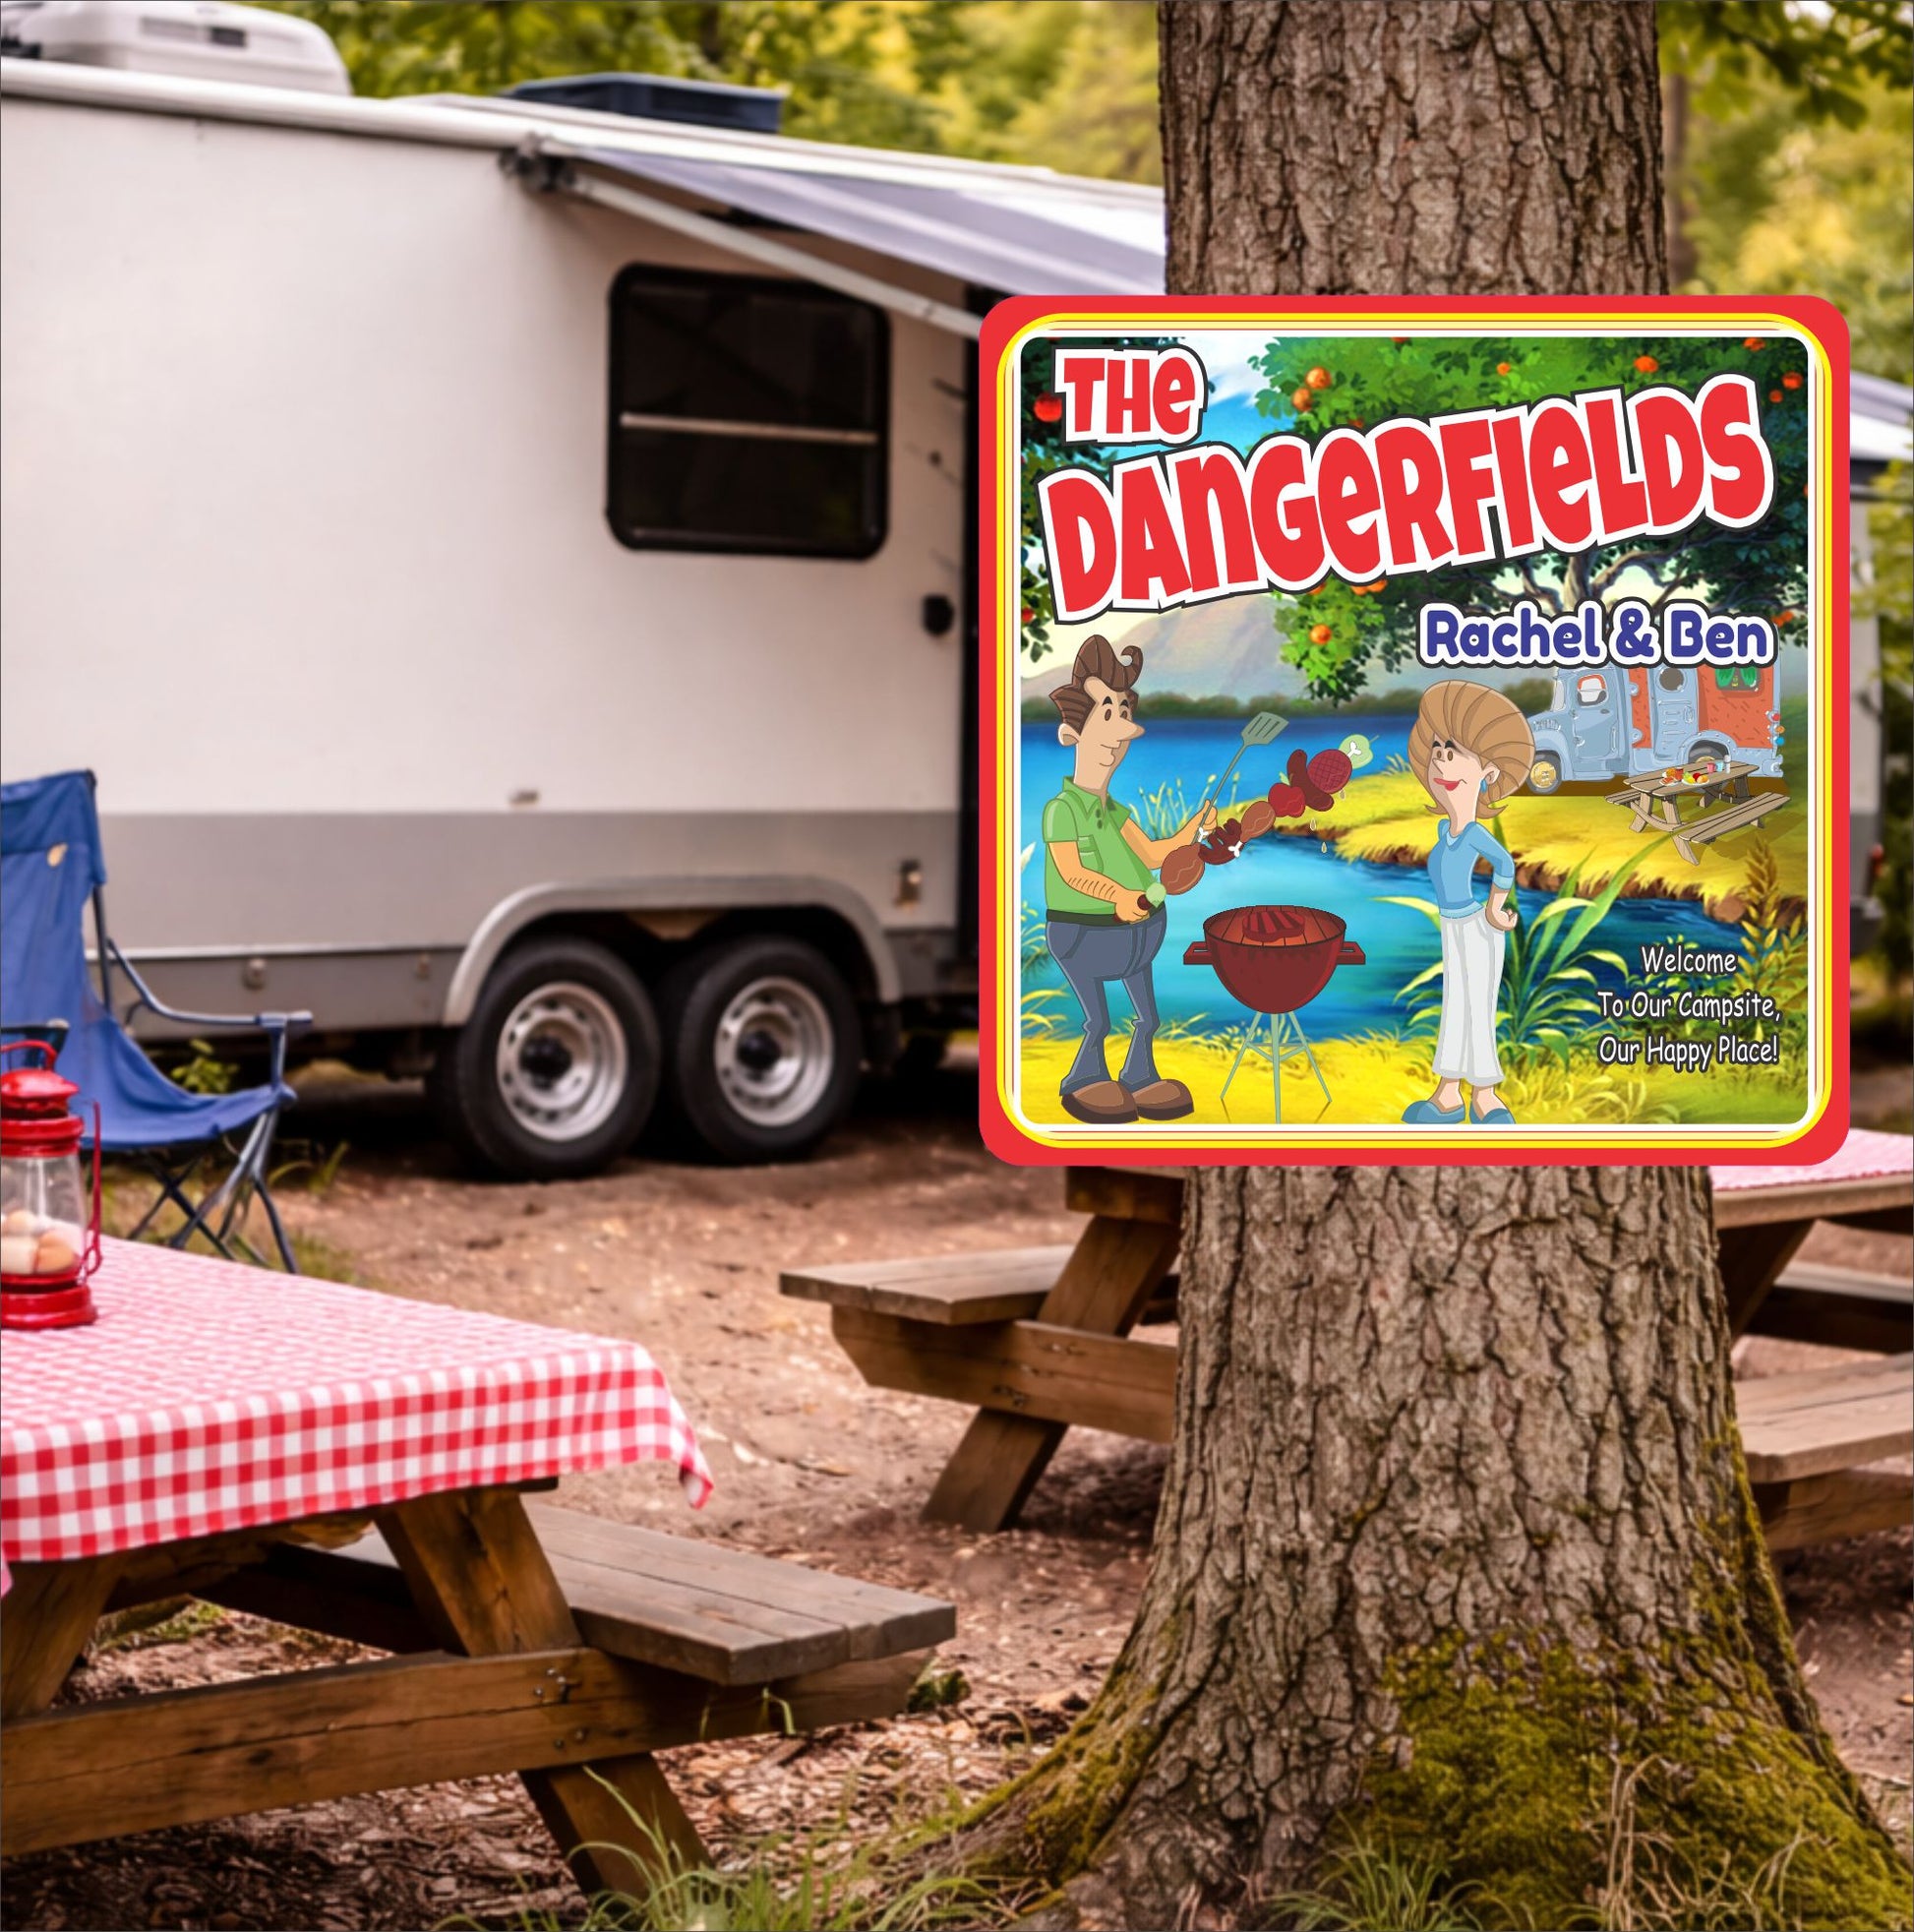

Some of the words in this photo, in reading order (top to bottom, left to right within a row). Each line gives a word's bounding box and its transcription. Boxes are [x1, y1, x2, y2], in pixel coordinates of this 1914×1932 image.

[1425, 606, 1601, 658] Rachel
[1615, 607, 1655, 658] &
[1670, 609, 1767, 658] Ben
[1641, 944, 1737, 973] Welcome
[1597, 991, 1623, 1017] To
[1631, 991, 1672, 1018] Our
[1678, 991, 1781, 1025] Campsite,
[1599, 1036, 1641, 1062] Our
[1646, 1035, 1712, 1070] Happy
[1718, 1035, 1779, 1062] Place!
